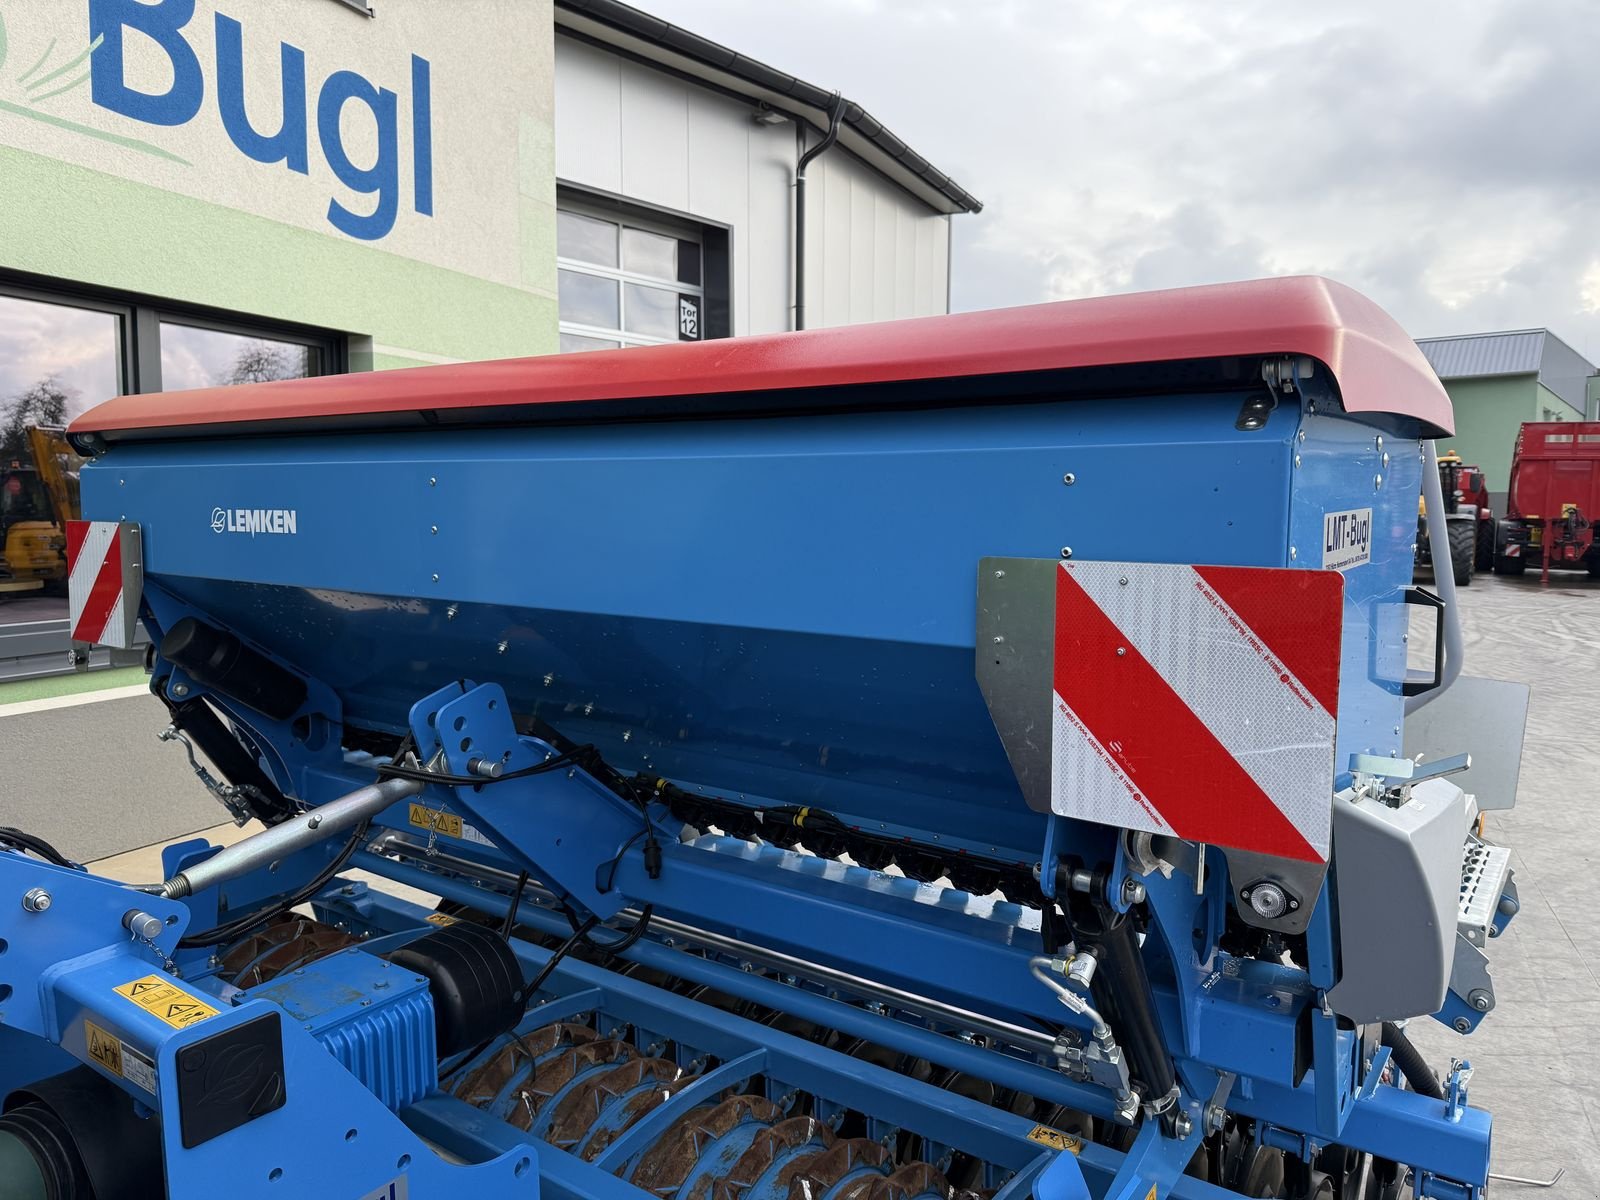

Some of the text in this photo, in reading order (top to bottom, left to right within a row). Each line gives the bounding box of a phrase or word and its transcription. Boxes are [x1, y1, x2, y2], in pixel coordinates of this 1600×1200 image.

[89, 0, 433, 241] Bugl
[681, 306, 697, 318] Tor
[681, 318, 697, 335] 12
[227, 509, 297, 539] LEMKEN
[1326, 511, 1370, 553] LMT-Bugl
